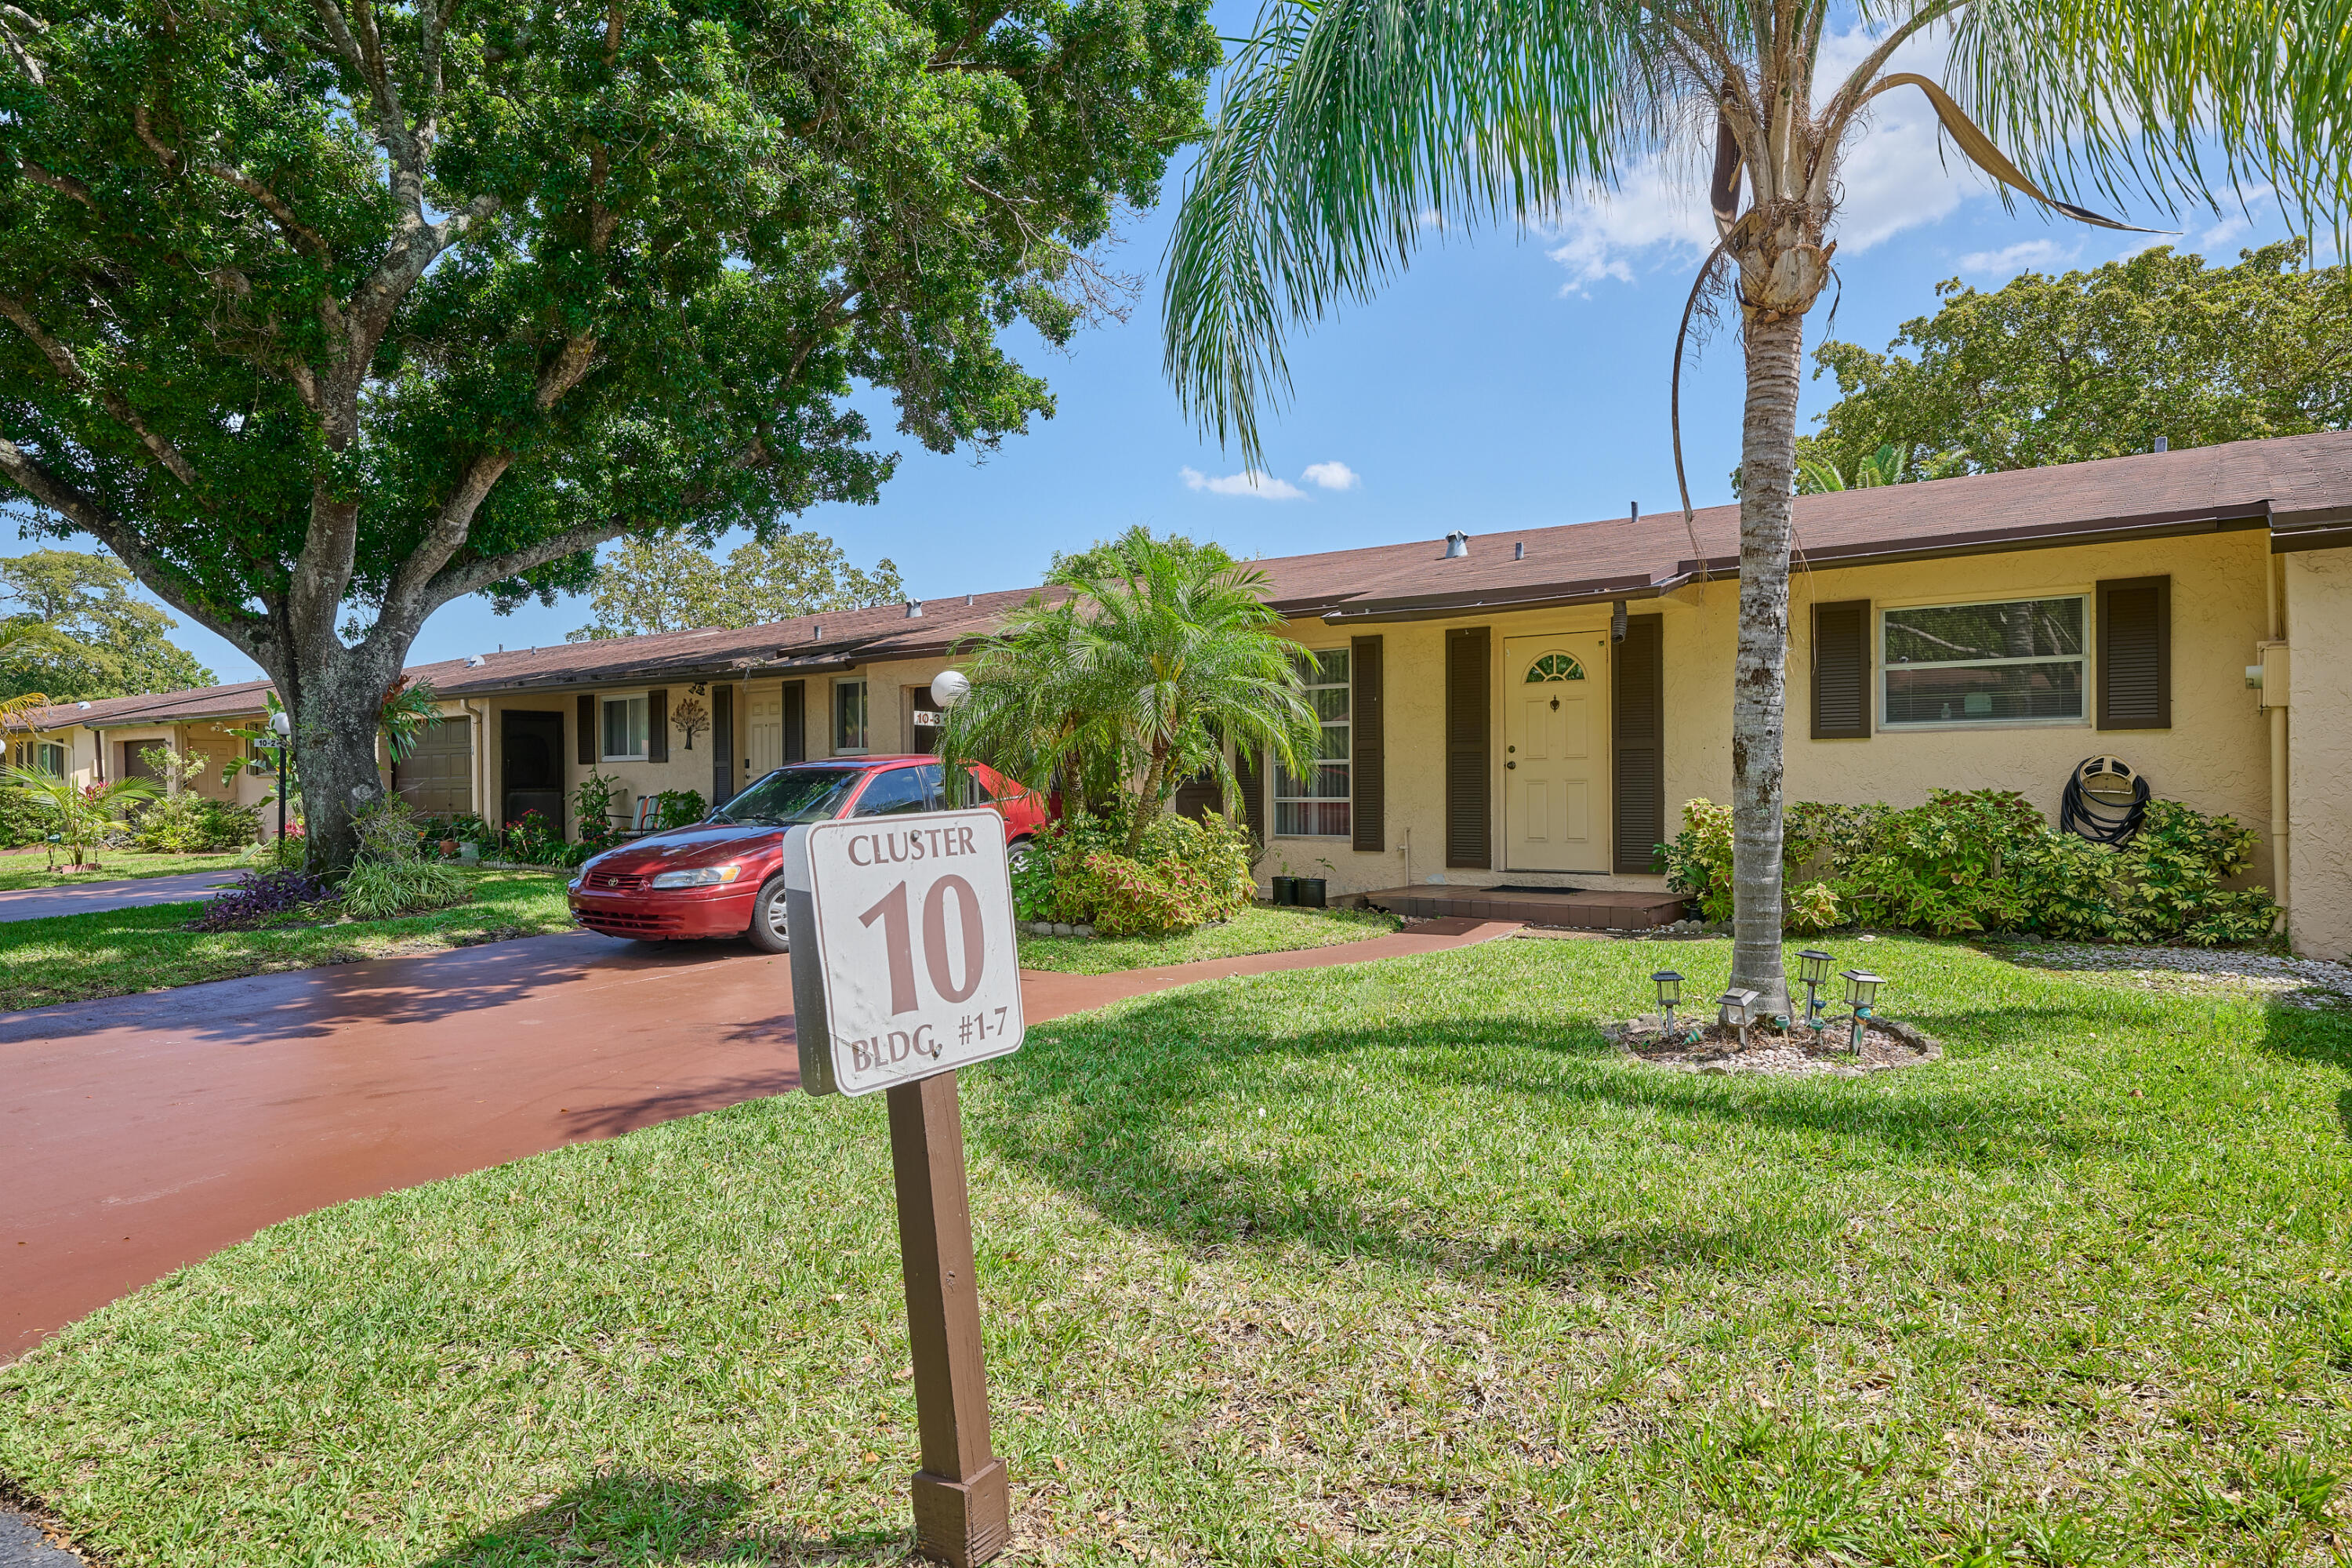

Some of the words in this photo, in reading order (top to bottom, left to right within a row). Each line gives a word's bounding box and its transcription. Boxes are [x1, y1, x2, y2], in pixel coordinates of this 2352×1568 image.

[917, 713, 940, 724] 10-3
[848, 826, 977, 866] CLUSTER
[858, 874, 985, 1016] 10
[959, 1006, 1007, 1045] #1-7
